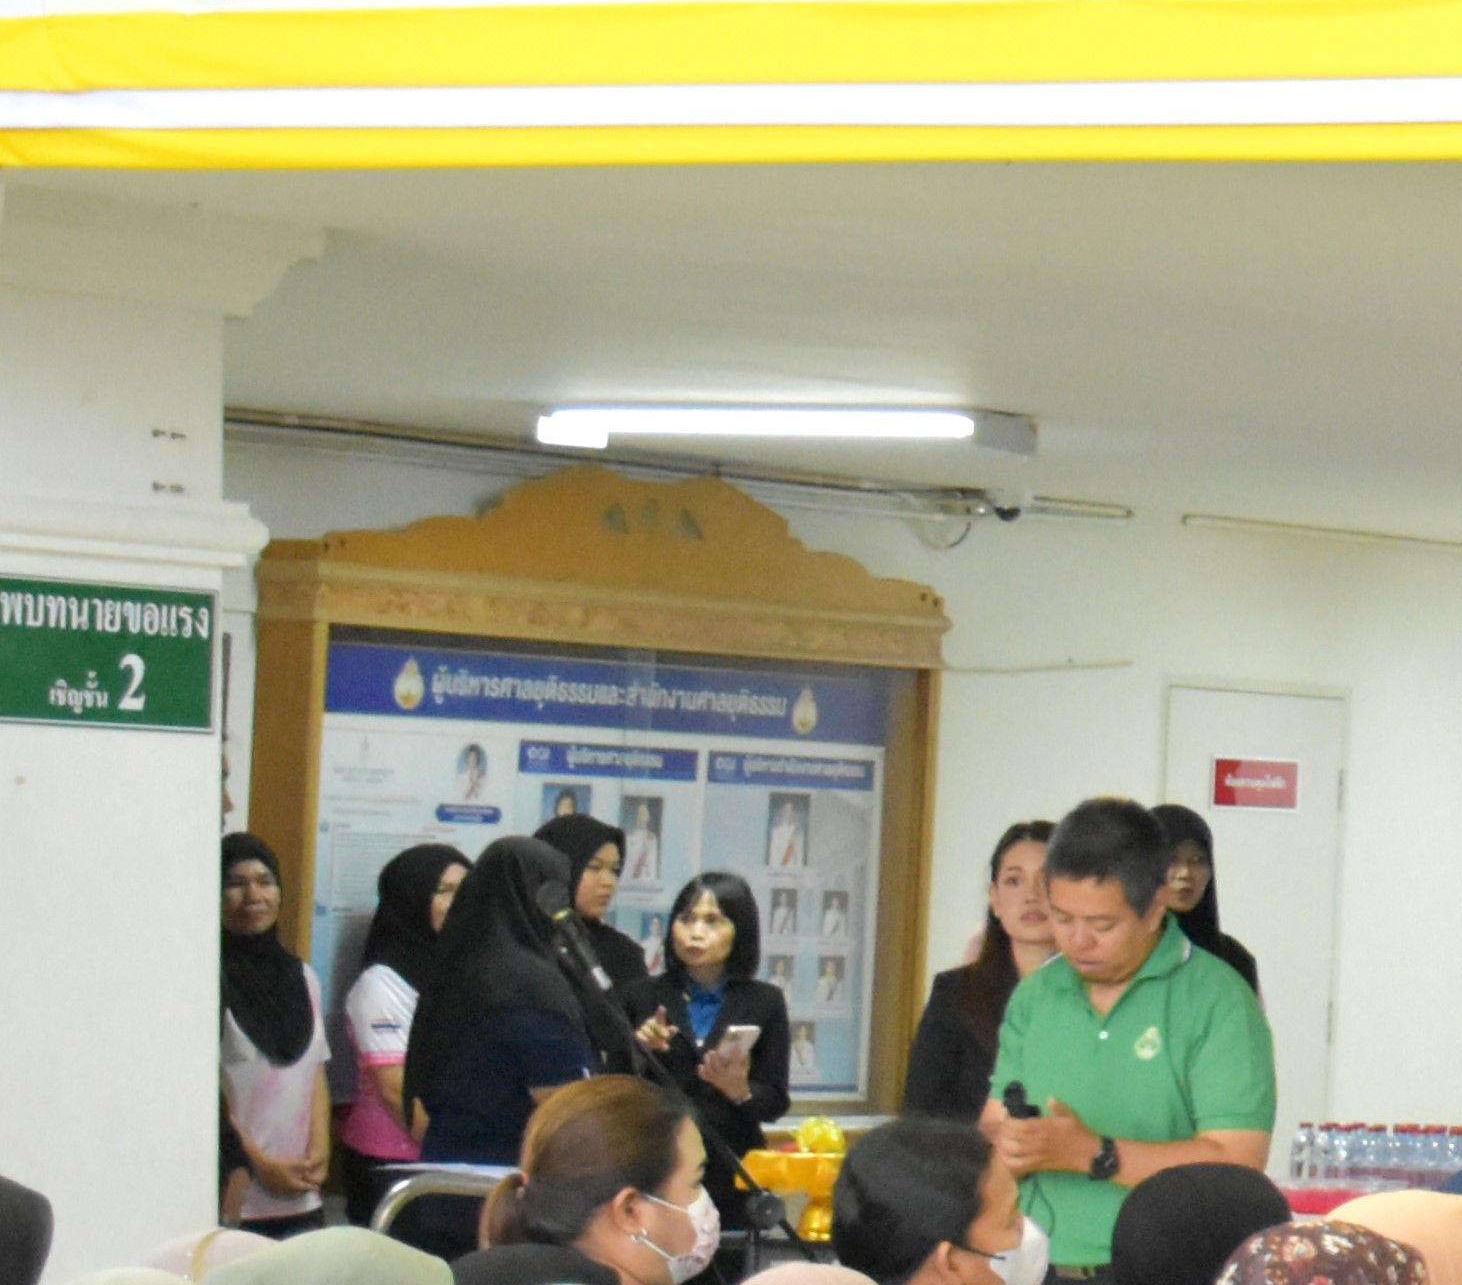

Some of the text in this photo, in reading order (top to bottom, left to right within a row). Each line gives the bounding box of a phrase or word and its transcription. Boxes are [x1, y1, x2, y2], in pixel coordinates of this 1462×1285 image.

[0, 591, 209, 639] พบทนายขอแรง
[49, 653, 146, 714] เชิญชั้น 2
